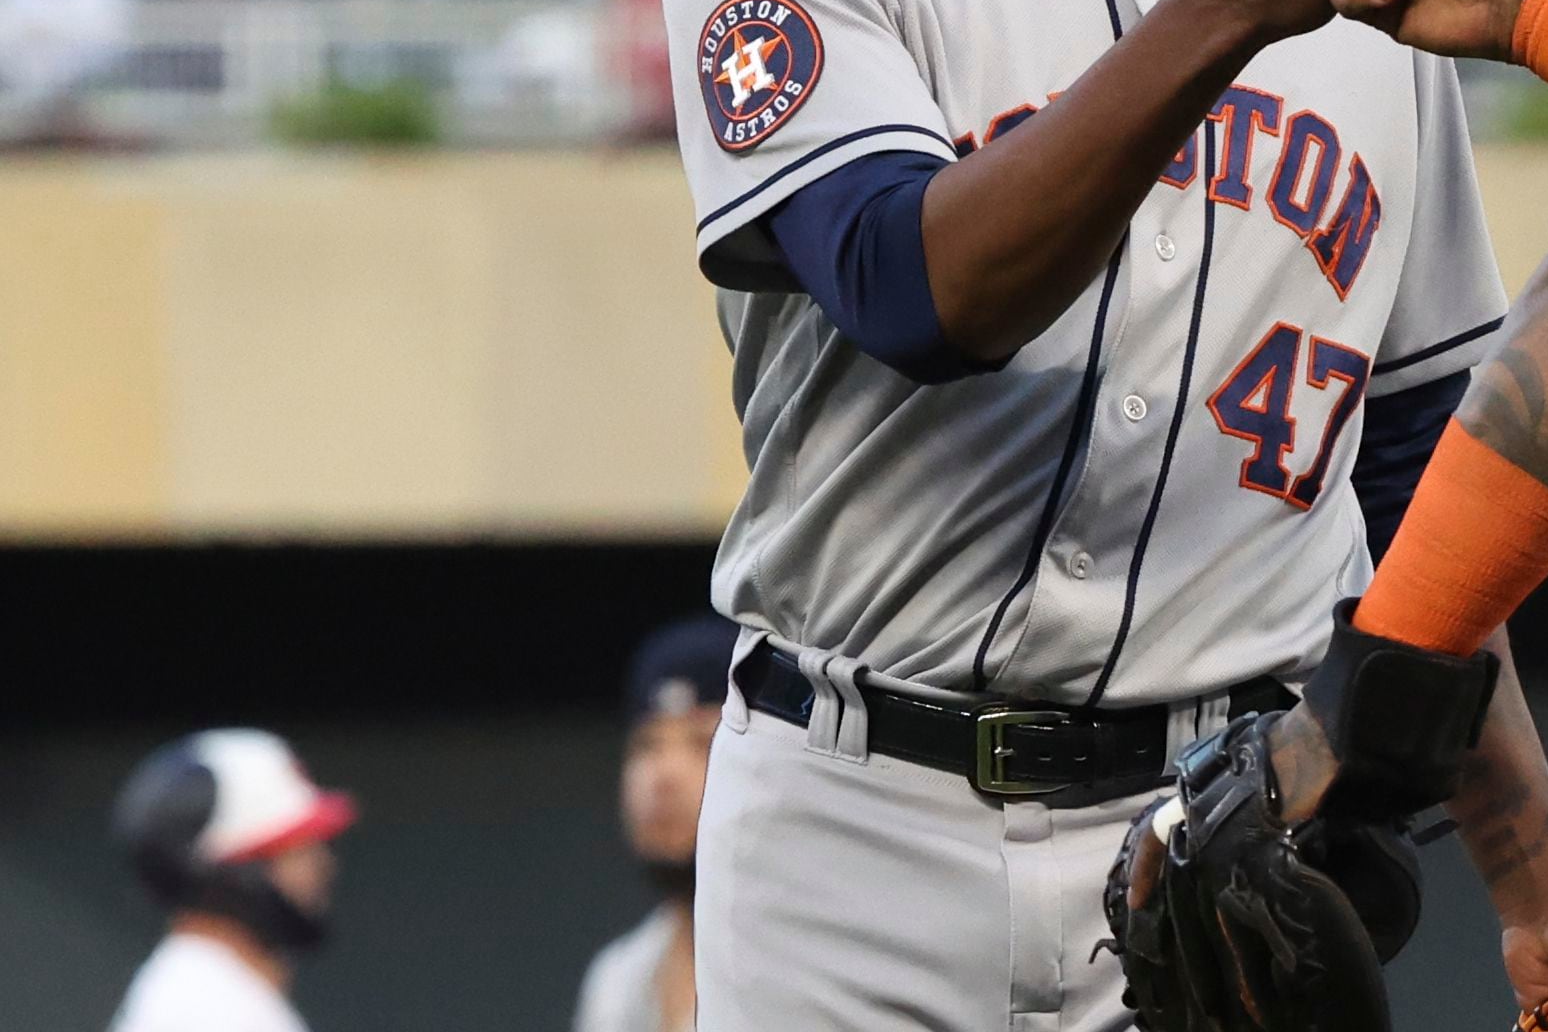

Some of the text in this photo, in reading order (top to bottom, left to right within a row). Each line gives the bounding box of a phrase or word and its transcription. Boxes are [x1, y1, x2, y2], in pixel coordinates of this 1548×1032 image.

[701, 0, 792, 74] HOUSTON
[724, 80, 803, 142] ASTROS
[1206, 321, 1370, 511] 47
